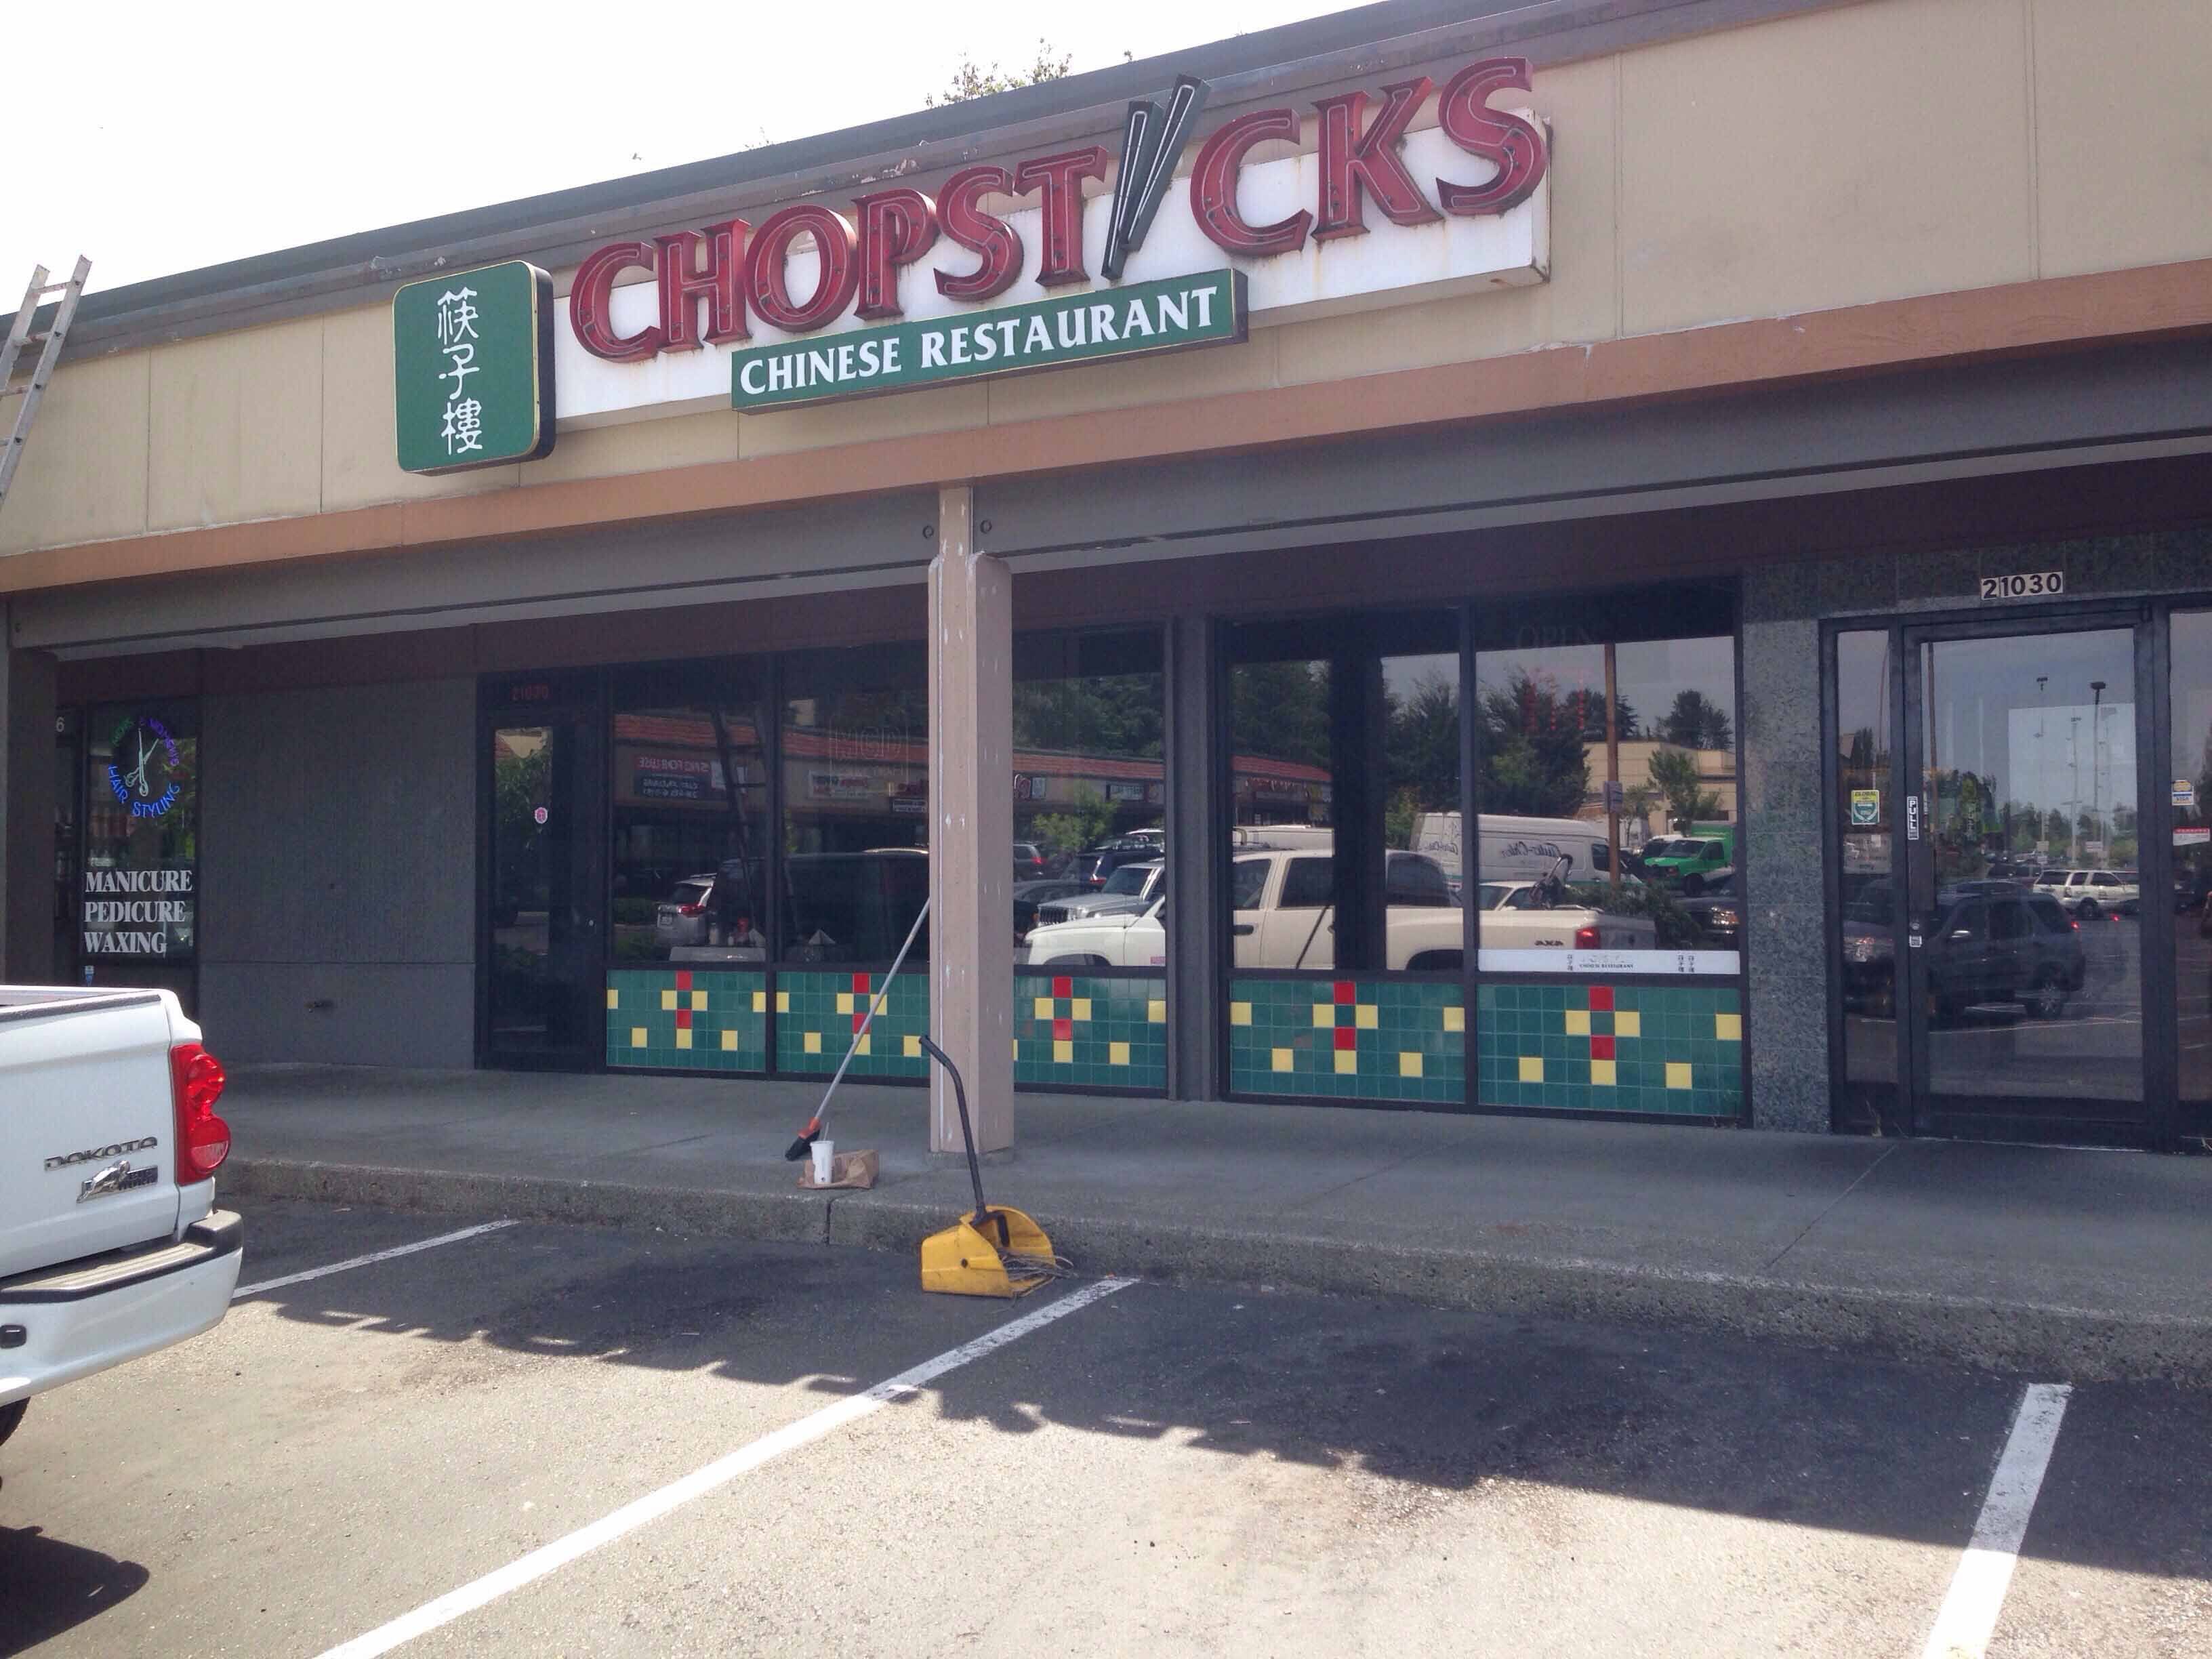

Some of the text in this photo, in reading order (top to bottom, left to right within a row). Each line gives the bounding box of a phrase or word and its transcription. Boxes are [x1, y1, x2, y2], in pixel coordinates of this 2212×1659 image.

[570, 56, 1548, 363] CHOPSTICKS
[740, 285, 1218, 397] CHINESE RESTAURANT
[1982, 573, 2062, 599] 21030
[108, 764, 180, 818] HAIR STYLING
[85, 870, 192, 893] MANICURE
[85, 901, 186, 922] PEDICURE
[84, 932, 167, 954] WAXING
[44, 1136, 158, 1172] DAKOTA
